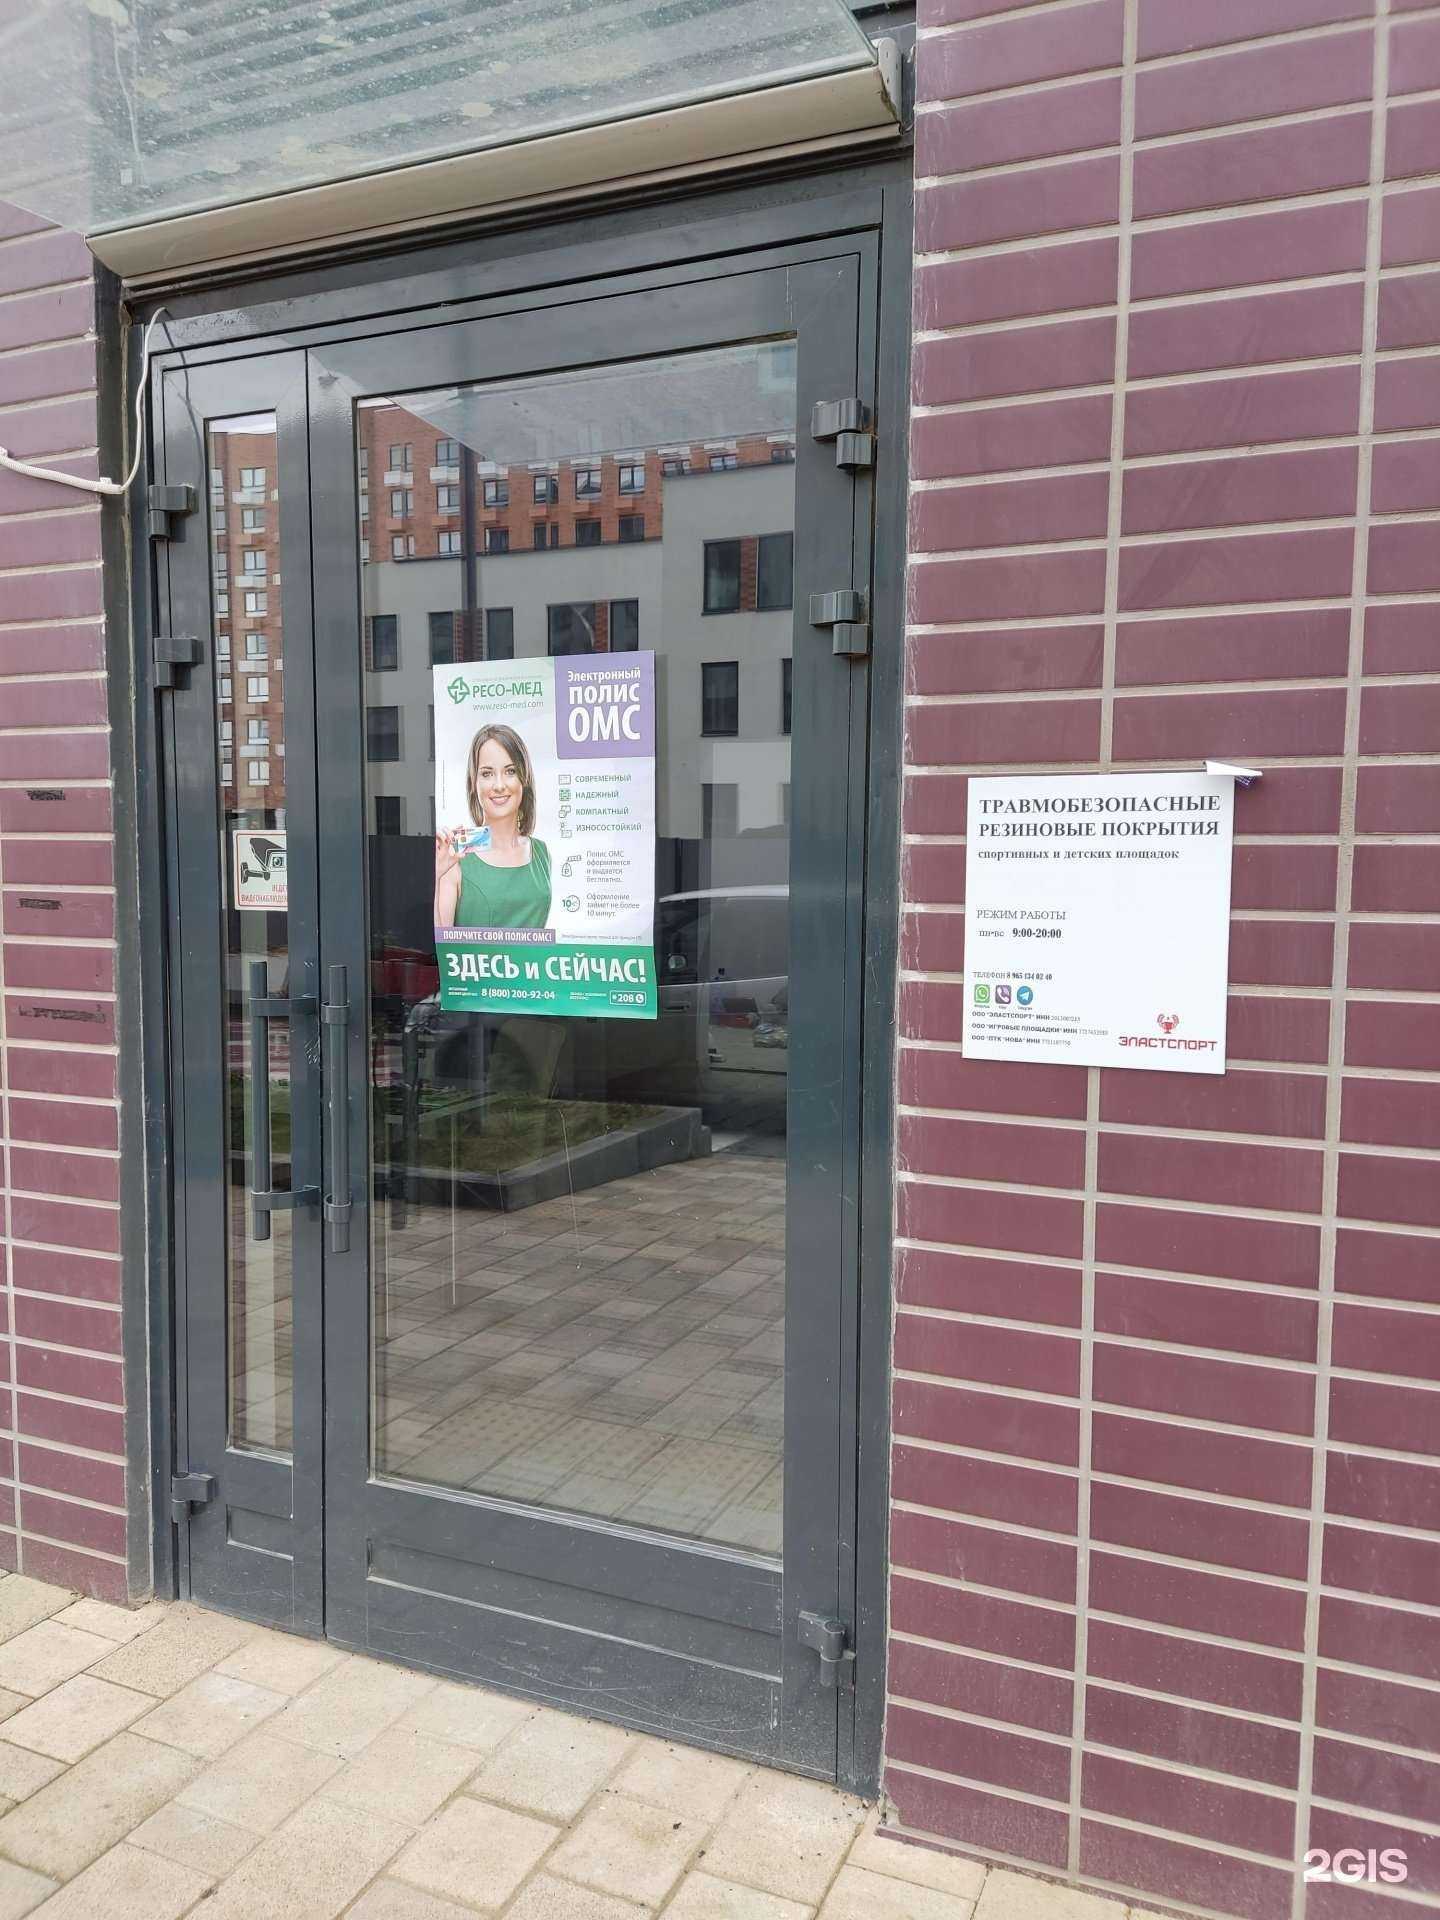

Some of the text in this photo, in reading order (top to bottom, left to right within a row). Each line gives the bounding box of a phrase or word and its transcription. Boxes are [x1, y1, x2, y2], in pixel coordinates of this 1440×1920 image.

[568, 667, 640, 682] Электронный
[473, 682, 543, 698] РЕСО-МЕД
[569, 682, 640, 704] ПОЛИС
[473, 700, 544, 711] www.reso-med.com
[568, 705, 640, 742] ОМС
[574, 774, 632, 782] СОВРЕМЕННЫЙ
[576, 790, 619, 799] НАДЕЖНЫЙ
[980, 795, 1221, 814] ТРАВМОБЕЗОПАСНЫЕ
[576, 807, 628, 815] КОМПАКТНЫЙ
[576, 823, 642, 831] ИЗНОСОСТОЙКИЙ
[979, 821, 1219, 837] РЕЗИНОВЫЕ ПОКРЫТИЯ
[978, 850, 1179, 861] спортивных и детских площадок
[977, 910, 1066, 920] РЕЖИМ РАБОТЫ
[444, 930, 482, 941] ПОЛУЧИТЕ
[483, 930, 503, 941] СВОЙ
[505, 931, 532, 941] ПОЛИС
[533, 932, 552, 942] ОМС!
[1012, 928, 1062, 938] 9:00-20:00
[446, 953, 646, 983] ЗДЕСЬ и СЕЙЧАС!
[482, 988, 487, 997] 8
[489, 988, 510, 998] (800)
[512, 990, 555, 1000] 200-92-04
[1118, 1036, 1217, 1051] ЭЛАСТСПОРТ
